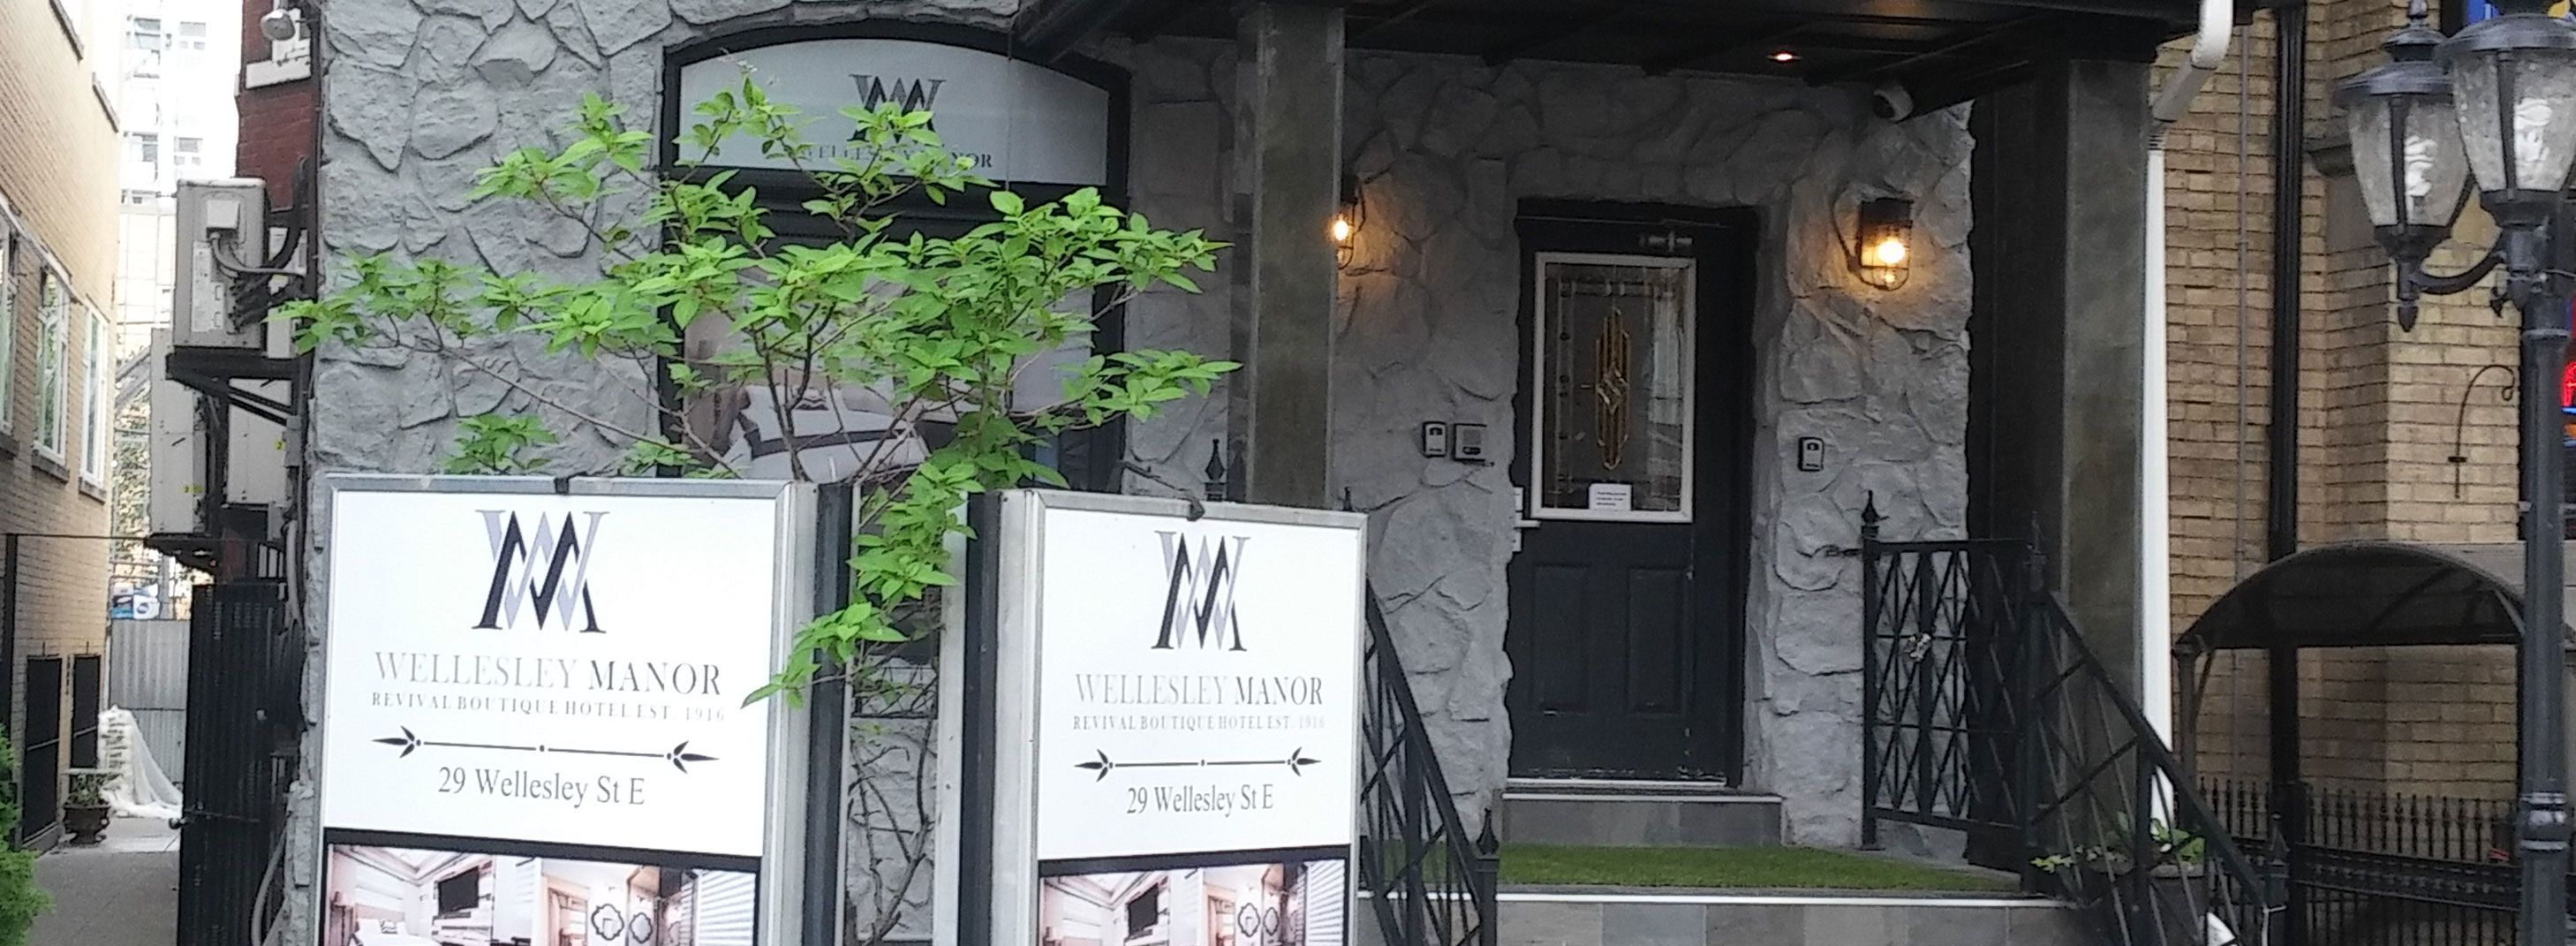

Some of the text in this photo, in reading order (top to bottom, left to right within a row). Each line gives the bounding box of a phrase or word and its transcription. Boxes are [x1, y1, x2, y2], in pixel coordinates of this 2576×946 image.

[374, 651, 721, 696] WELLESLEY MANOR
[1075, 673, 1323, 706] WELLESLEY MANOR
[372, 691, 451, 710] REVIVAL
[457, 695, 559, 715] BOUTIQUE
[565, 700, 631, 718] HOTEL
[1073, 715, 1137, 730] REVIVAL
[1140, 715, 1214, 732] BOUTIQUE
[1218, 715, 1263, 730] HOTEL
[438, 766, 646, 809] 29 Wellesley St E
[1126, 783, 1274, 818] 29 Wellesley St E
